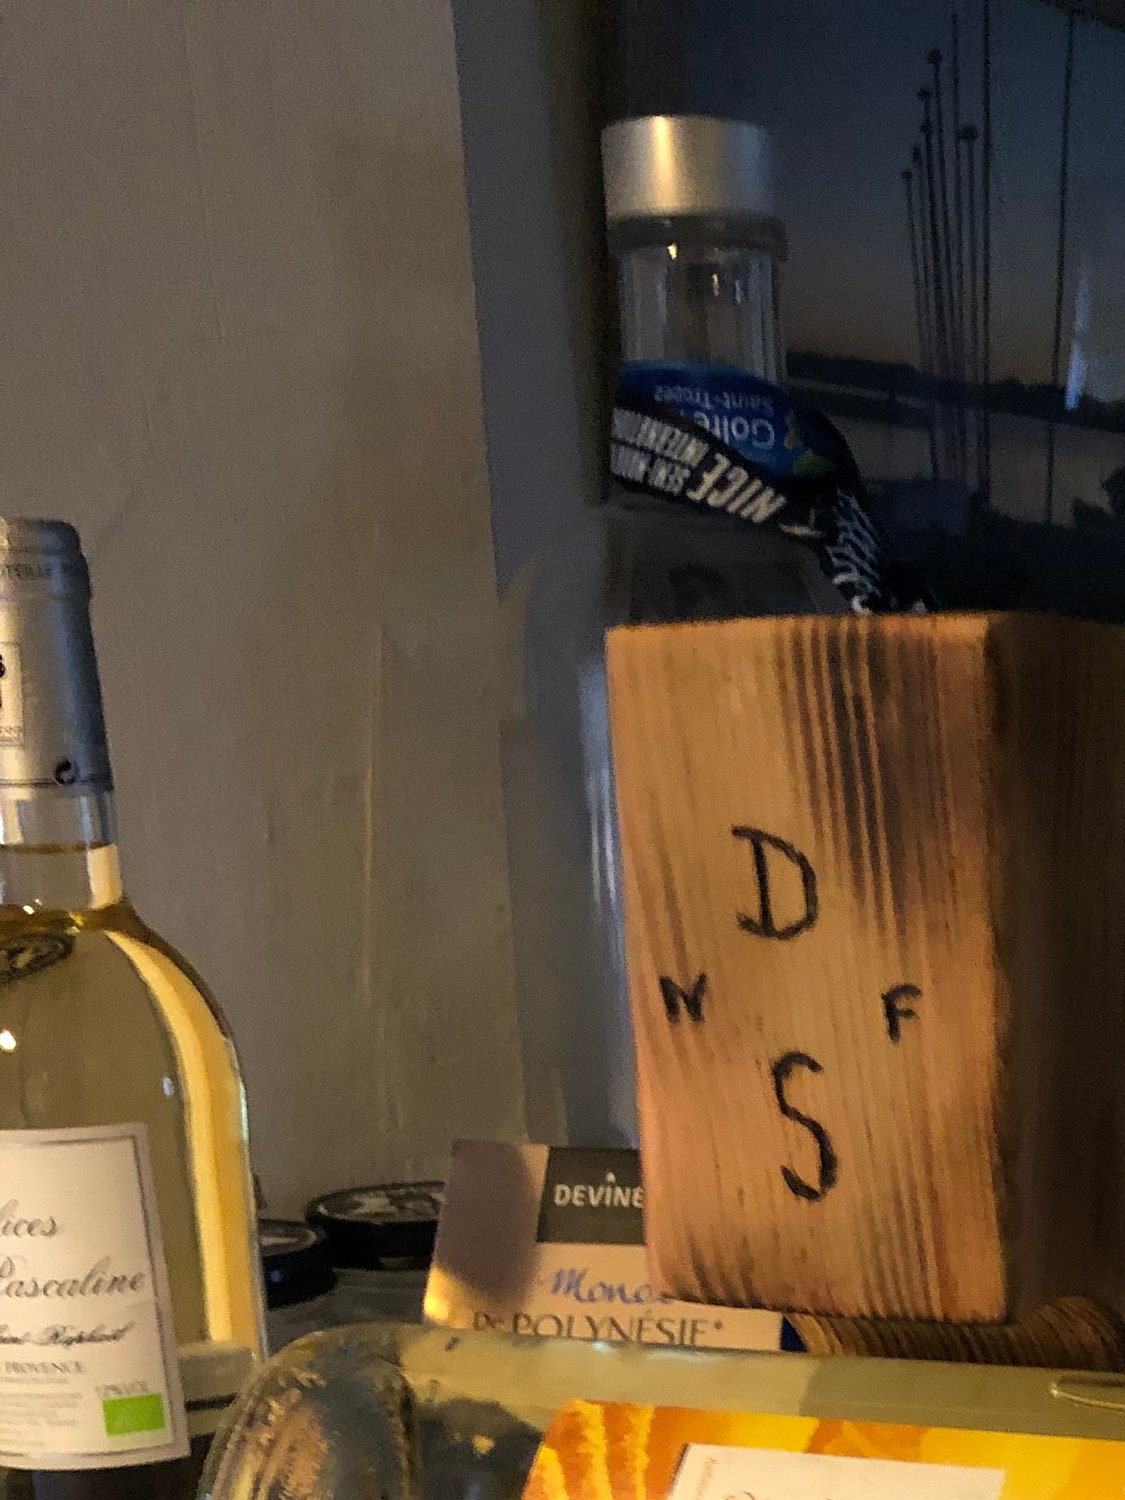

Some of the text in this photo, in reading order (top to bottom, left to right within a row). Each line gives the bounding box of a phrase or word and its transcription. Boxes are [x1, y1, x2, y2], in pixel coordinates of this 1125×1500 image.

[685, 452, 787, 525] NICE
[732, 825, 819, 941] D
[772, 1051, 839, 1202] S
[551, 1267, 674, 1305] Mono
